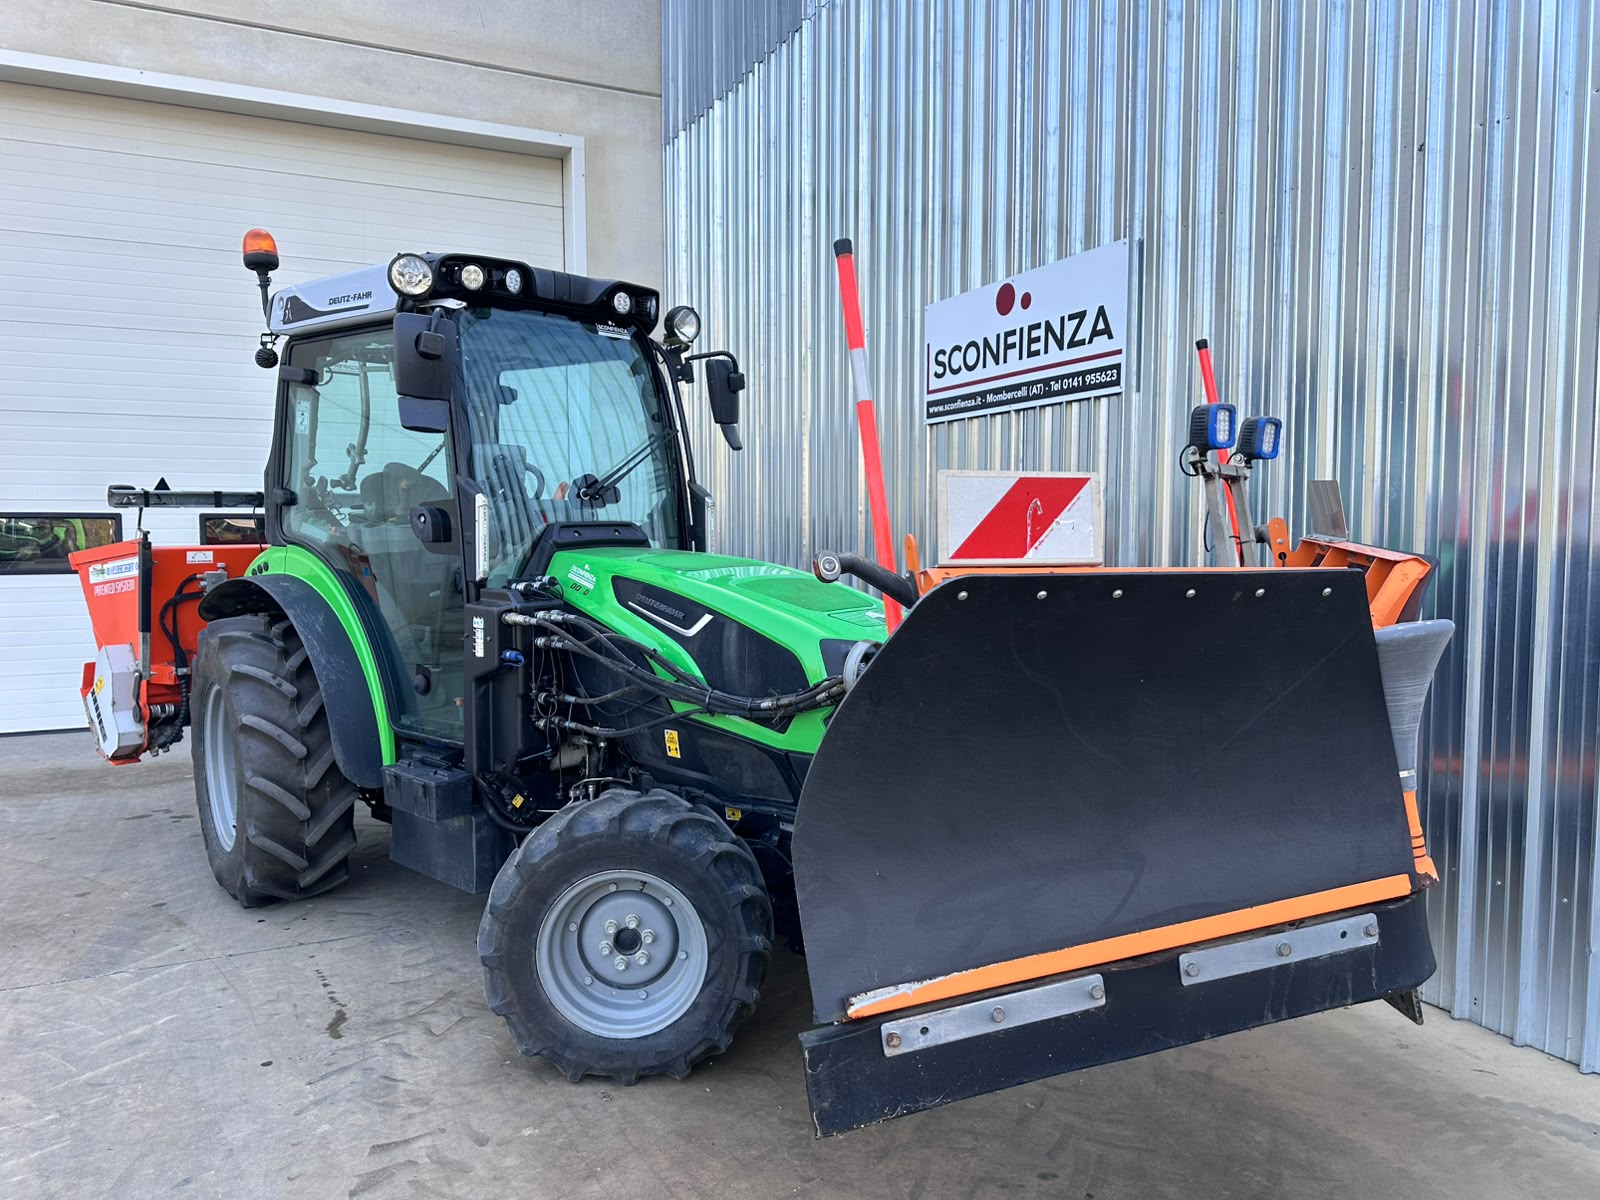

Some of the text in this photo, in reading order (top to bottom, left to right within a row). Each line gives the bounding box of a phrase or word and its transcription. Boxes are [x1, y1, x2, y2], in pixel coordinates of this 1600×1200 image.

[328, 291, 372, 305] DEUTZ-FAHR
[934, 305, 1114, 379] SCONFIENZA
[928, 396, 982, 414] www.sconfienza.it
[986, 385, 1028, 404] Mombercelli
[1029, 383, 1044, 398] (AT)
[1050, 379, 1061, 392] Tel
[1062, 375, 1082, 390] 0141
[1085, 369, 1118, 385] 955623
